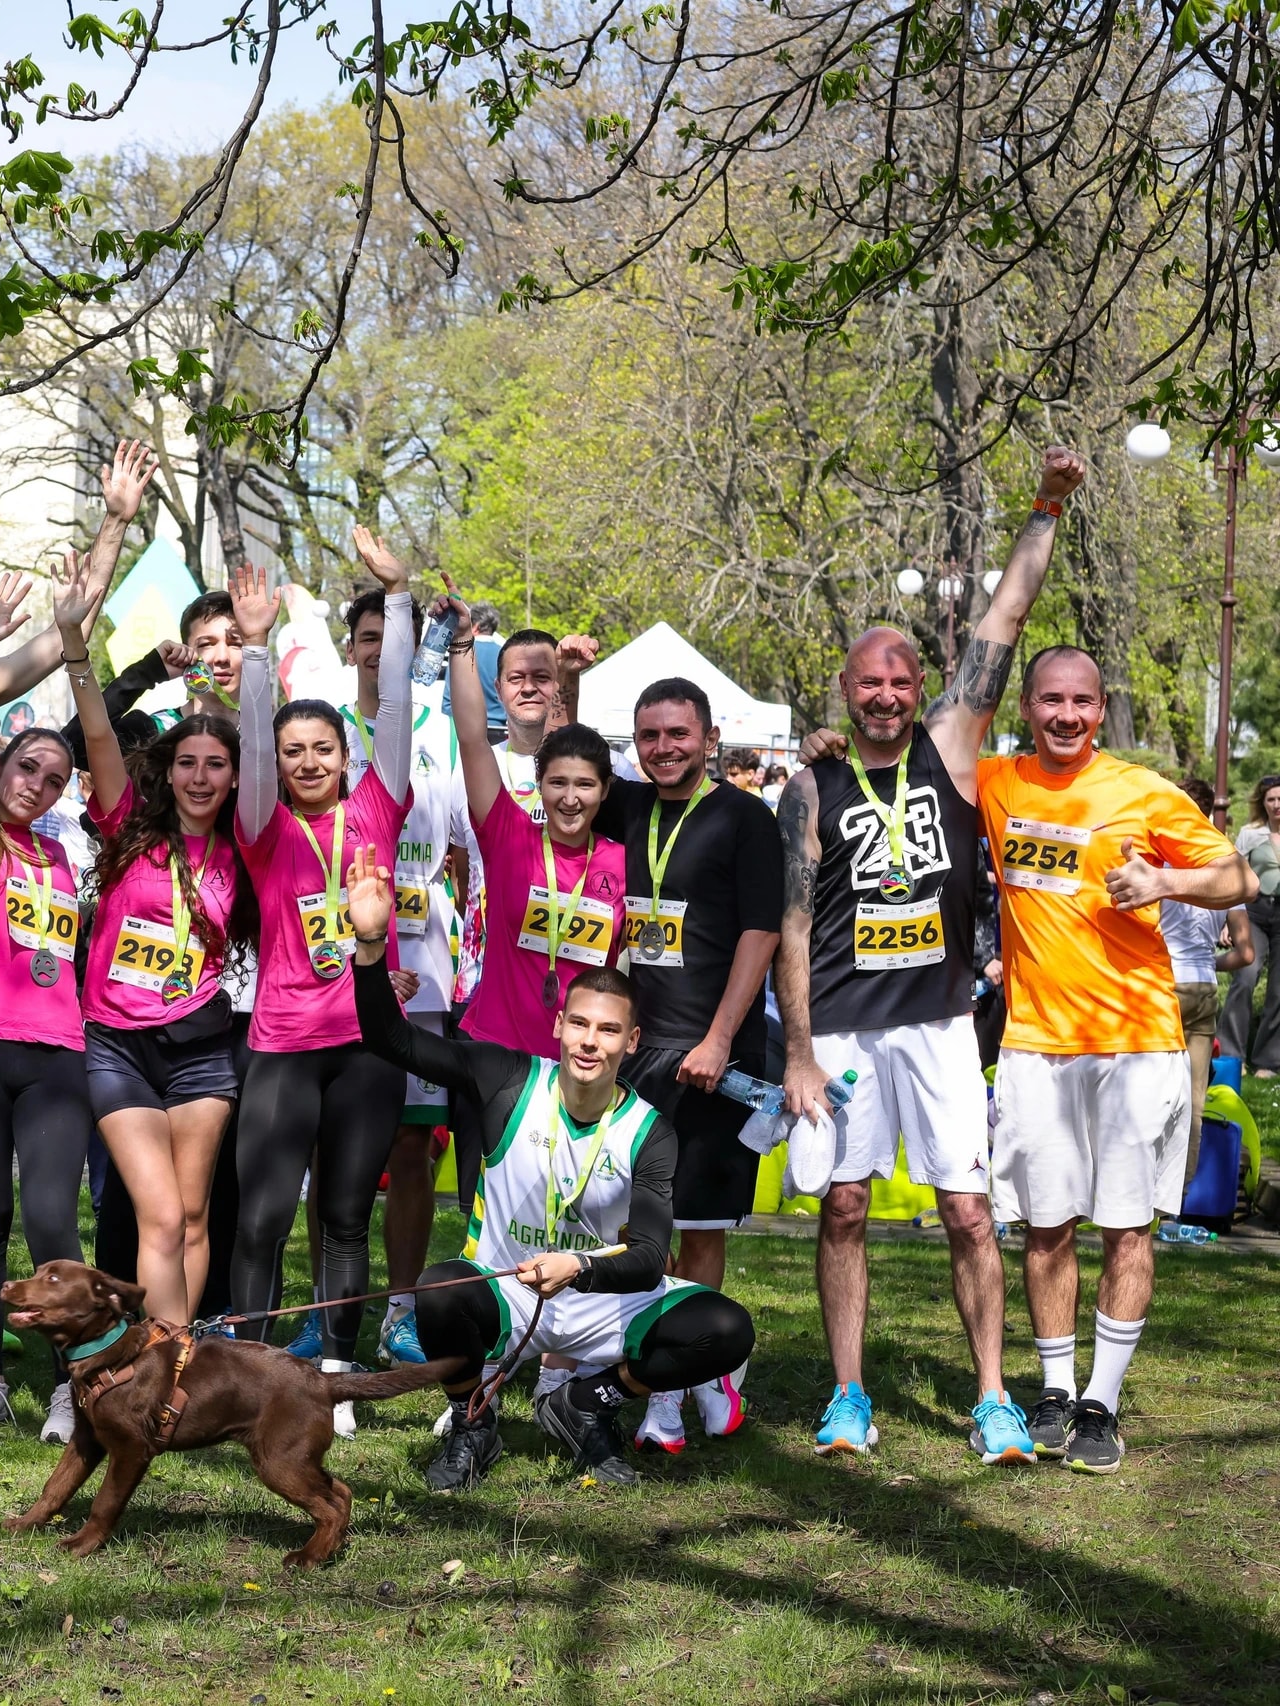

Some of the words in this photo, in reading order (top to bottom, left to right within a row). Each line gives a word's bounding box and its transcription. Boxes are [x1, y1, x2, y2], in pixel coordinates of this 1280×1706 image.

[1003, 838, 1079, 874] 2254
[626, 917, 677, 947] 220
[857, 920, 939, 950] 2256
